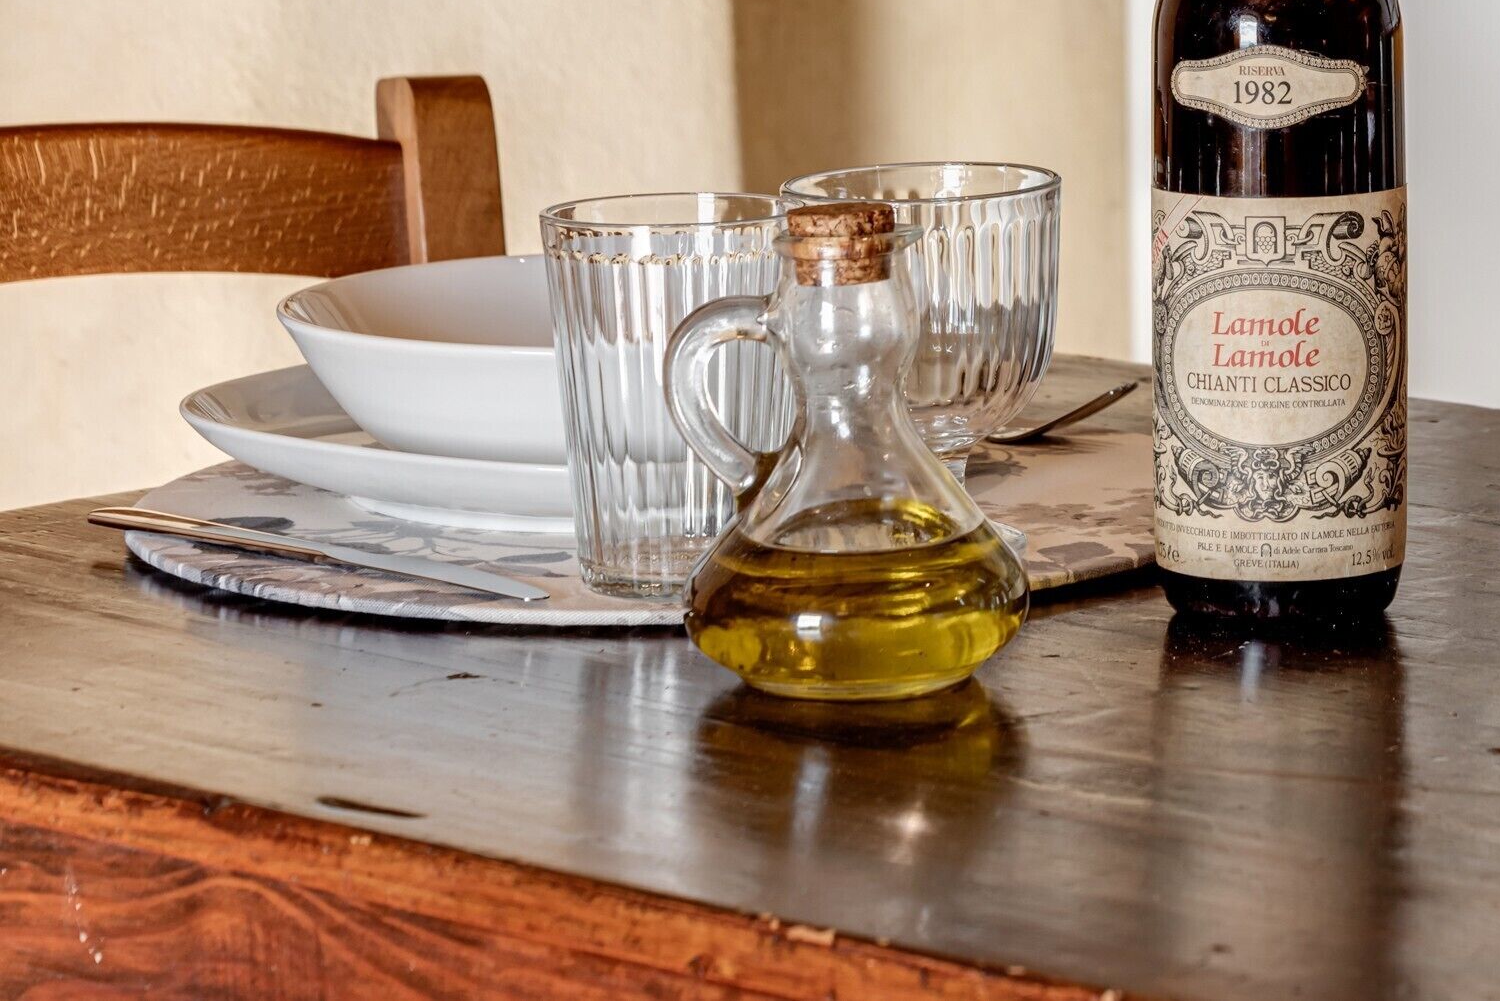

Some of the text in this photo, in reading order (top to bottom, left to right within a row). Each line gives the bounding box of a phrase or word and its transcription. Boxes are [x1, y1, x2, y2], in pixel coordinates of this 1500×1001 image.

[1239, 65, 1285, 76] RISERVA
[1233, 80, 1292, 105] 1982
[1211, 308, 1320, 336] Lamole
[1211, 341, 1320, 368] Lamole
[1187, 372, 1351, 393] CHIANTI CLASSICO
[1191, 397, 1346, 408] DENOMINAZIONE D'ORIGINE CONTROLLATA
[1176, 524, 1220, 538] INVECCHIATO
[1230, 532, 1297, 540] IMBOTTIGLIATO
[1300, 531, 1309, 540] IN
[1311, 529, 1345, 540] LAMOLE
[1346, 526, 1370, 537] NELLA
[1216, 544, 1222, 552] E
[1224, 544, 1258, 554] LAMOLE
[1273, 546, 1280, 554] di
[1282, 546, 1301, 554] Adele
[1302, 545, 1328, 554] Carrara
[1233, 559, 1300, 569] GREVE (ITALIA)
